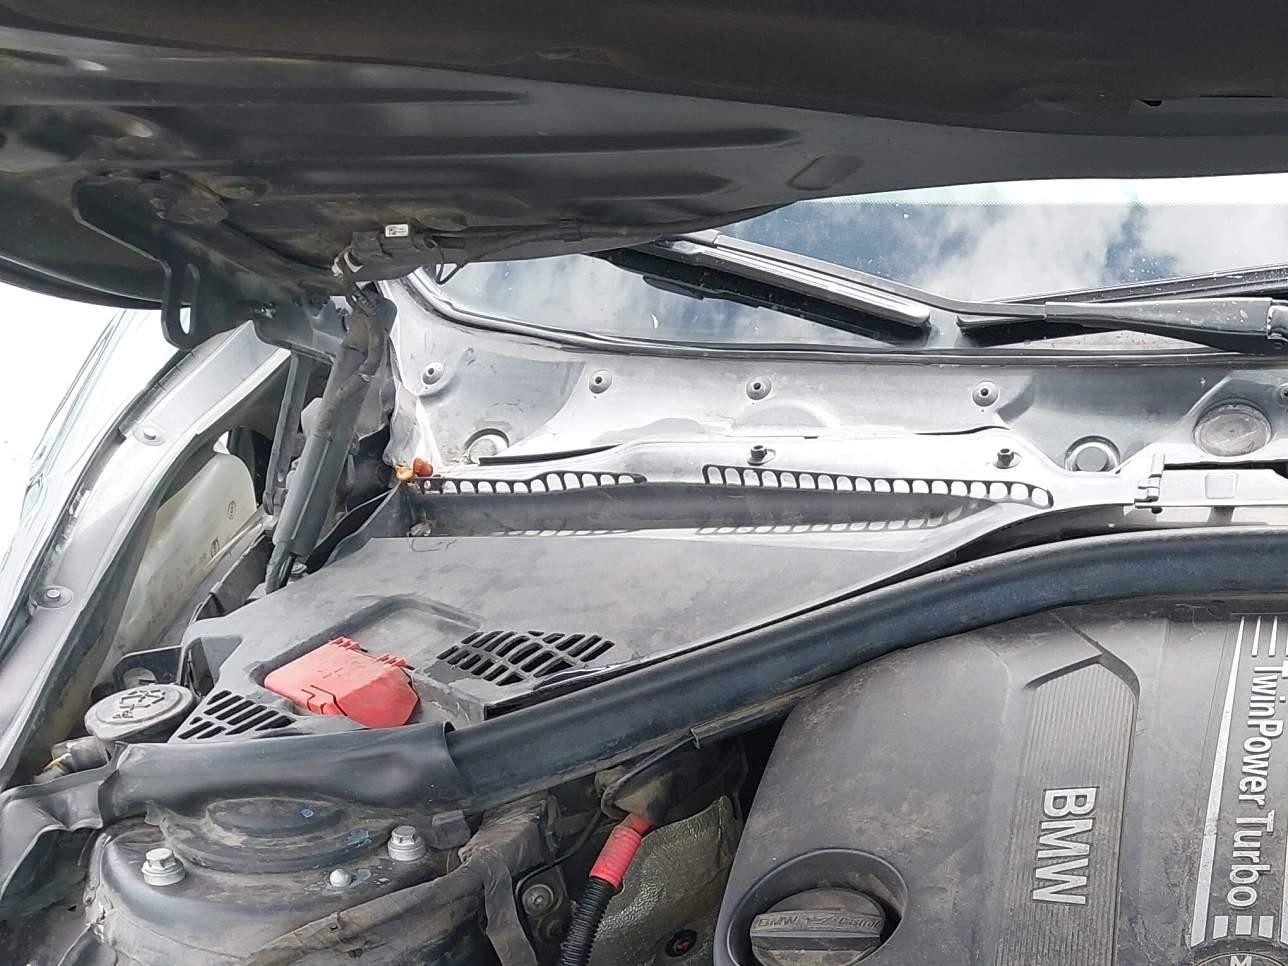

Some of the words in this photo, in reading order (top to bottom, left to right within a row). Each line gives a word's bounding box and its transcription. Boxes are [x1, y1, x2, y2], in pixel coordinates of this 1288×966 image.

[1032, 787, 1097, 905] BMW
[1226, 809, 1275, 909] Turbo
[757, 915, 799, 928] BMW
